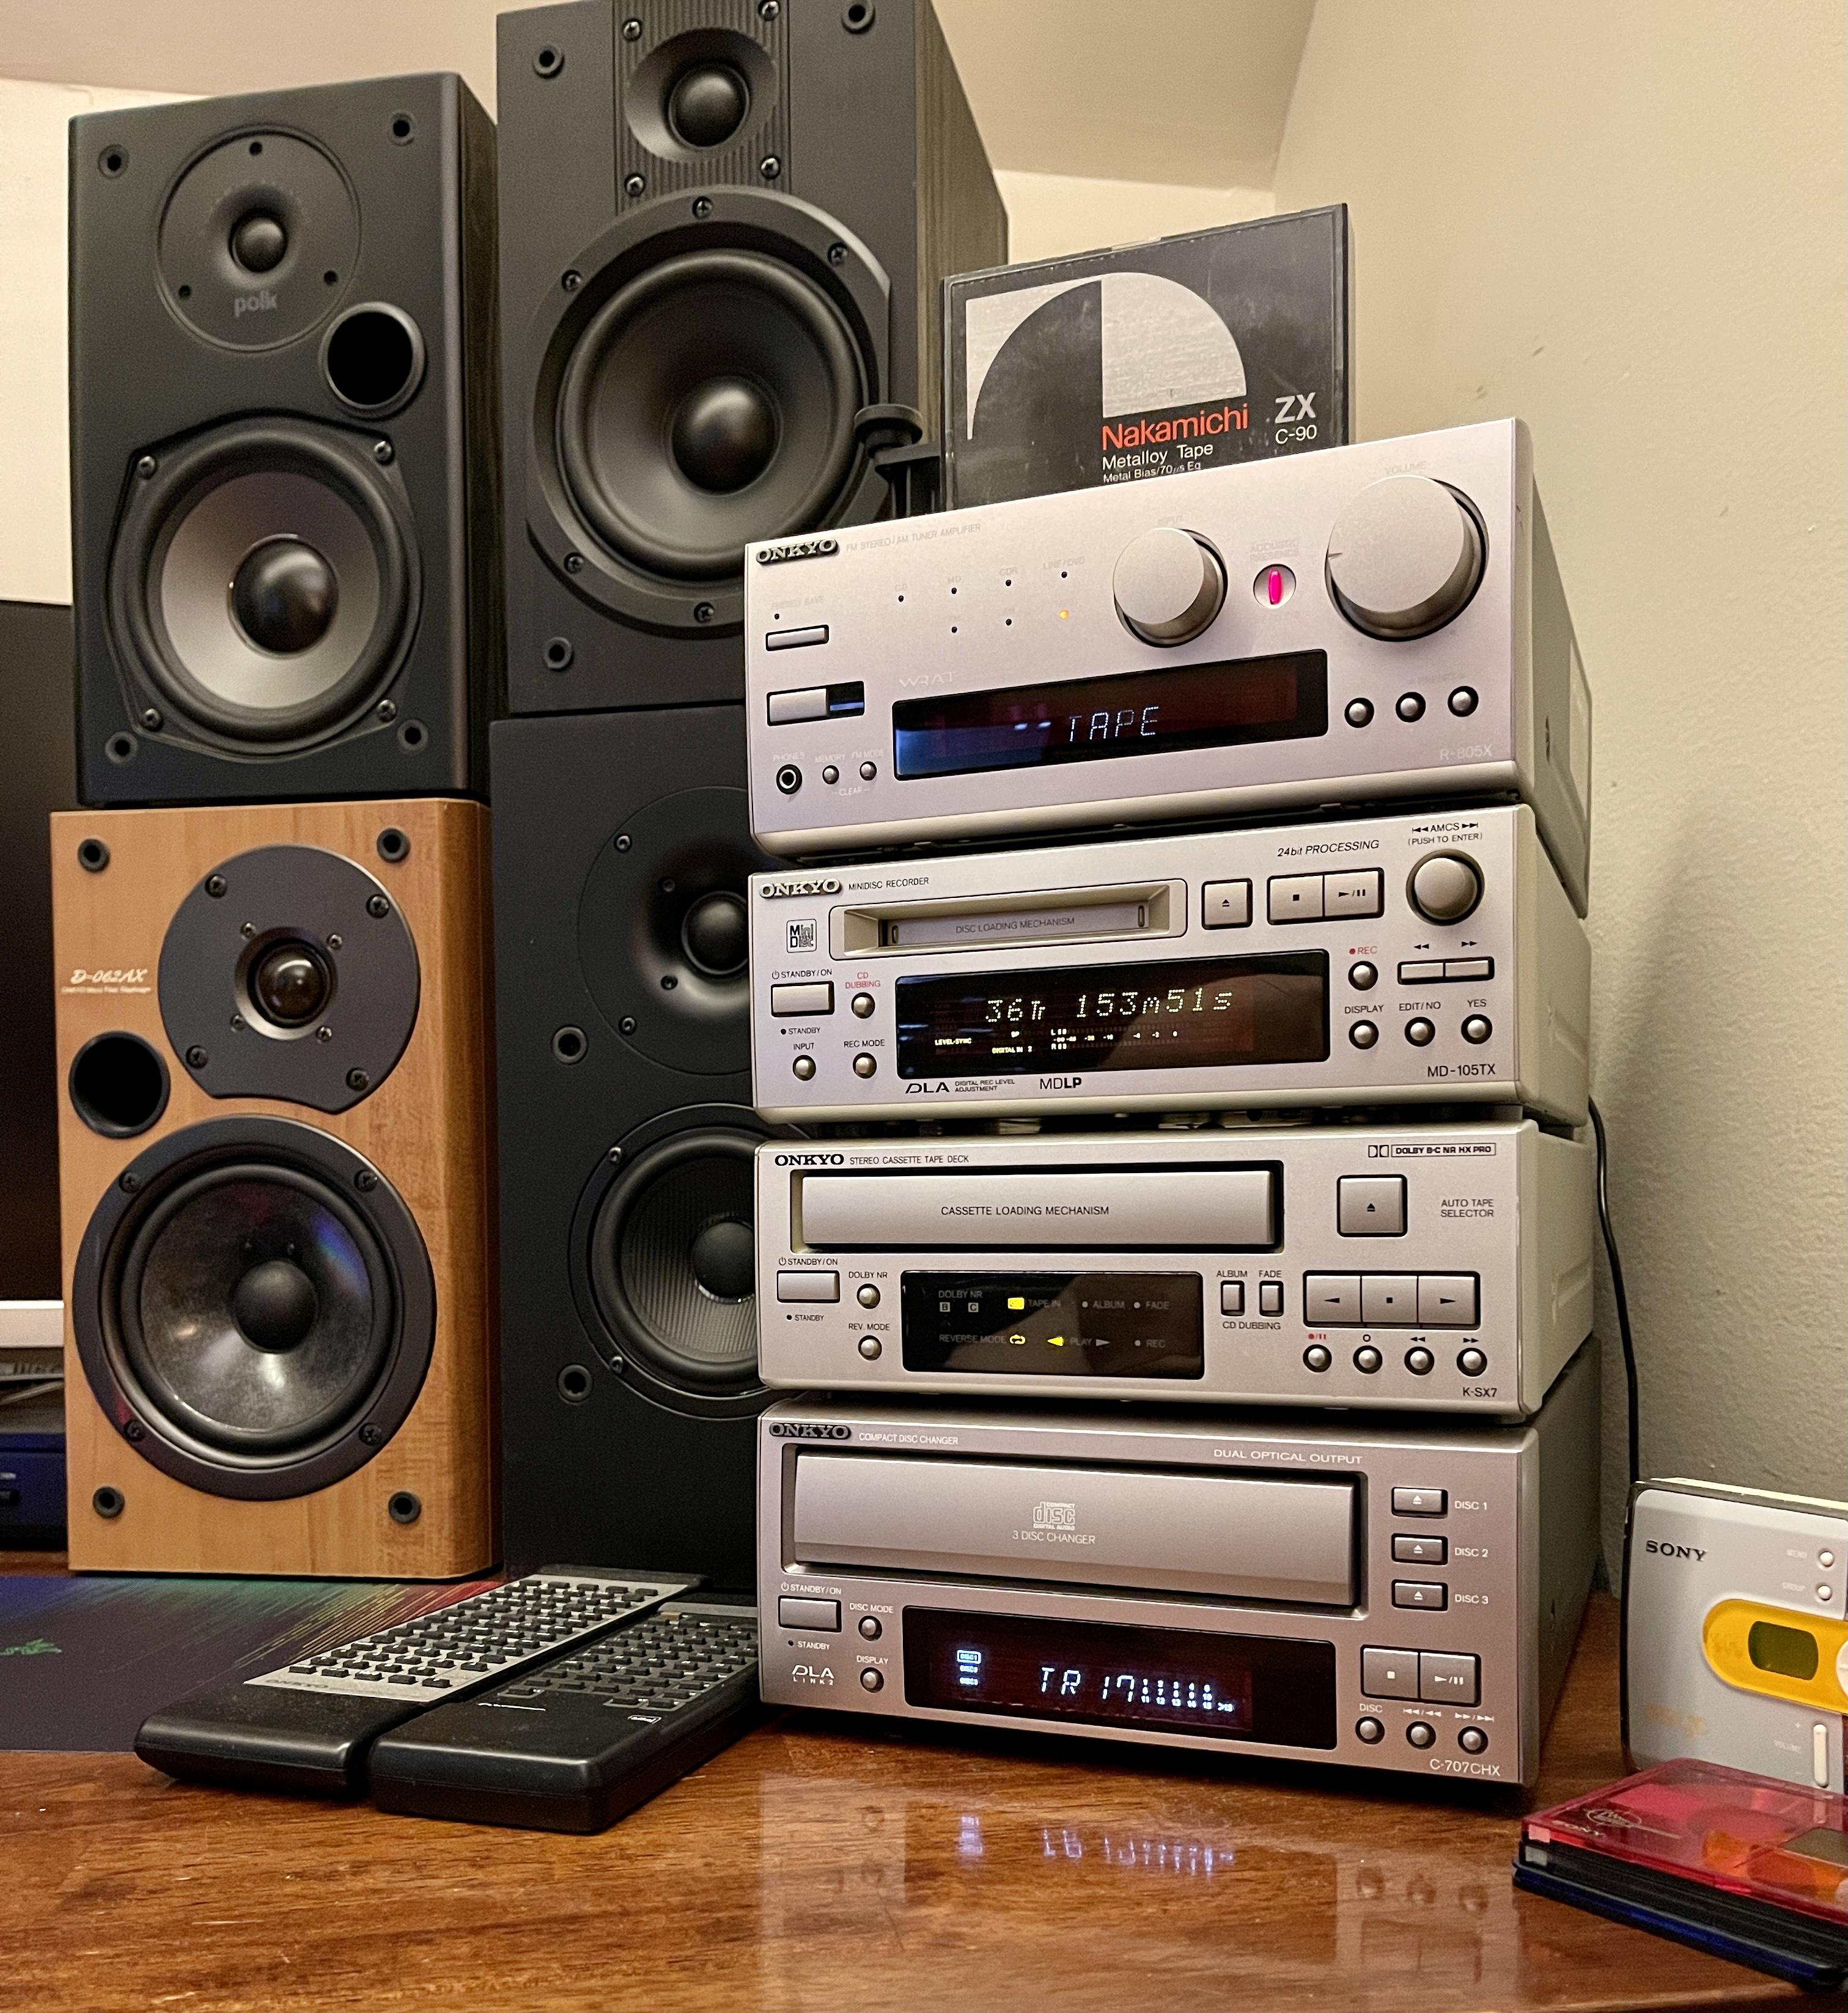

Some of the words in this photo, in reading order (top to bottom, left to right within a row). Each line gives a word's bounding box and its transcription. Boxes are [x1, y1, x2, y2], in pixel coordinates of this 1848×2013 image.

[234, 291, 278, 317] polk
[1275, 391, 1317, 424] ZX
[1102, 403, 1249, 451] Nakamichi
[1275, 424, 1317, 445] C-90
[1102, 449, 1168, 470] Metalloy
[1177, 443, 1213, 461] Tape
[1103, 469, 1131, 483] Metal
[1188, 462, 1201, 472] Eq
[1385, 460, 1427, 474] VOLUME
[912, 532, 938, 542] TUNER
[940, 523, 981, 537] AMPLIFIER
[756, 539, 838, 564] ONKYO
[899, 672, 956, 688] WRAT
[1069, 705, 1160, 742] TAPE
[773, 752, 806, 762] PHONES
[864, 749, 885, 758] MODE
[1439, 744, 1493, 761] R-805X
[815, 753, 846, 764] MEMORY
[839, 787, 863, 796] CLEAR
[1430, 822, 1460, 832] AMCS
[1277, 846, 1303, 857] 24bit
[1305, 839, 1380, 855] PROCESSING
[759, 878, 840, 898] ONKYO
[849, 880, 883, 891] MINIDISC
[886, 877, 929, 888] RECORDER
[955, 924, 976, 934] DISC
[979, 921, 1018, 932] LOADING
[1020, 917, 1075, 929] MECHANISM
[1357, 946, 1378, 955] REC
[845, 981, 881, 989] DUBBING
[1467, 999, 1487, 1007] YES
[1344, 1004, 1384, 1014] DISPLAY
[1427, 1063, 1496, 1077] MD-105TX
[905, 1081, 951, 1094] DLA
[1040, 1077, 1082, 1090] MDLP
[775, 1154, 844, 1166] ONKYO
[1441, 1199, 1468, 1207] AUTO
[941, 1206, 992, 1215] CASSETTE
[996, 1206, 1042, 1215] LOADING
[1045, 1205, 1110, 1215] MECHANISM
[1440, 1209, 1494, 1218] SELECTOR
[1216, 1270, 1248, 1278] ALBUM
[1259, 1270, 1282, 1278] FADE
[938, 1290, 966, 1299] DOLBY
[967, 1290, 983, 1299] NR
[941, 1303, 949, 1312] B
[970, 1303, 978, 1312] C
[1028, 1299, 1048, 1308] TAPE
[1050, 1299, 1061, 1308] IN
[1093, 1300, 1125, 1309] ALBUM
[1146, 1301, 1169, 1309] FADE
[1222, 1321, 1237, 1330] CD
[1239, 1322, 1281, 1330] DUBBING
[939, 1334, 978, 1343] REVERSE
[980, 1335, 1007, 1344] MODE
[1070, 1338, 1092, 1346] PLAY
[1146, 1339, 1166, 1348] REC
[1462, 1387, 1497, 1397] K-SX7
[769, 1422, 850, 1439] ONKYO
[859, 1432, 897, 1442] COMPACT
[899, 1434, 918, 1443] DISC
[919, 1435, 959, 1444] CHANGER
[1213, 1449, 1246, 1459] DUAL
[1250, 1451, 1306, 1462] OPTICAL
[1309, 1453, 1363, 1464] OUTPUT
[1454, 1501, 1479, 1510] DISC
[1483, 1501, 1487, 1511] 1
[1012, 1530, 1018, 1539] 3
[1022, 1531, 1044, 1540] DISC
[1047, 1533, 1095, 1544] CHANGER
[1454, 1547, 1479, 1557] DISC
[1482, 1548, 1489, 1558] 2
[1646, 1539, 1707, 1562] SONY
[1454, 1594, 1479, 1603] DISC
[1482, 1595, 1489, 1605] 3
[849, 1602, 869, 1611] DISC
[871, 1604, 894, 1614] MODE
[797, 1641, 830, 1651] STANDBY
[856, 1655, 888, 1665] DISPLAY
[1041, 1666, 1081, 1695] TR
[1102, 1674, 1135, 1703] 17
[1359, 1703, 1383, 1713] DISC
[1429, 1758, 1500, 1776] C-707CHX
